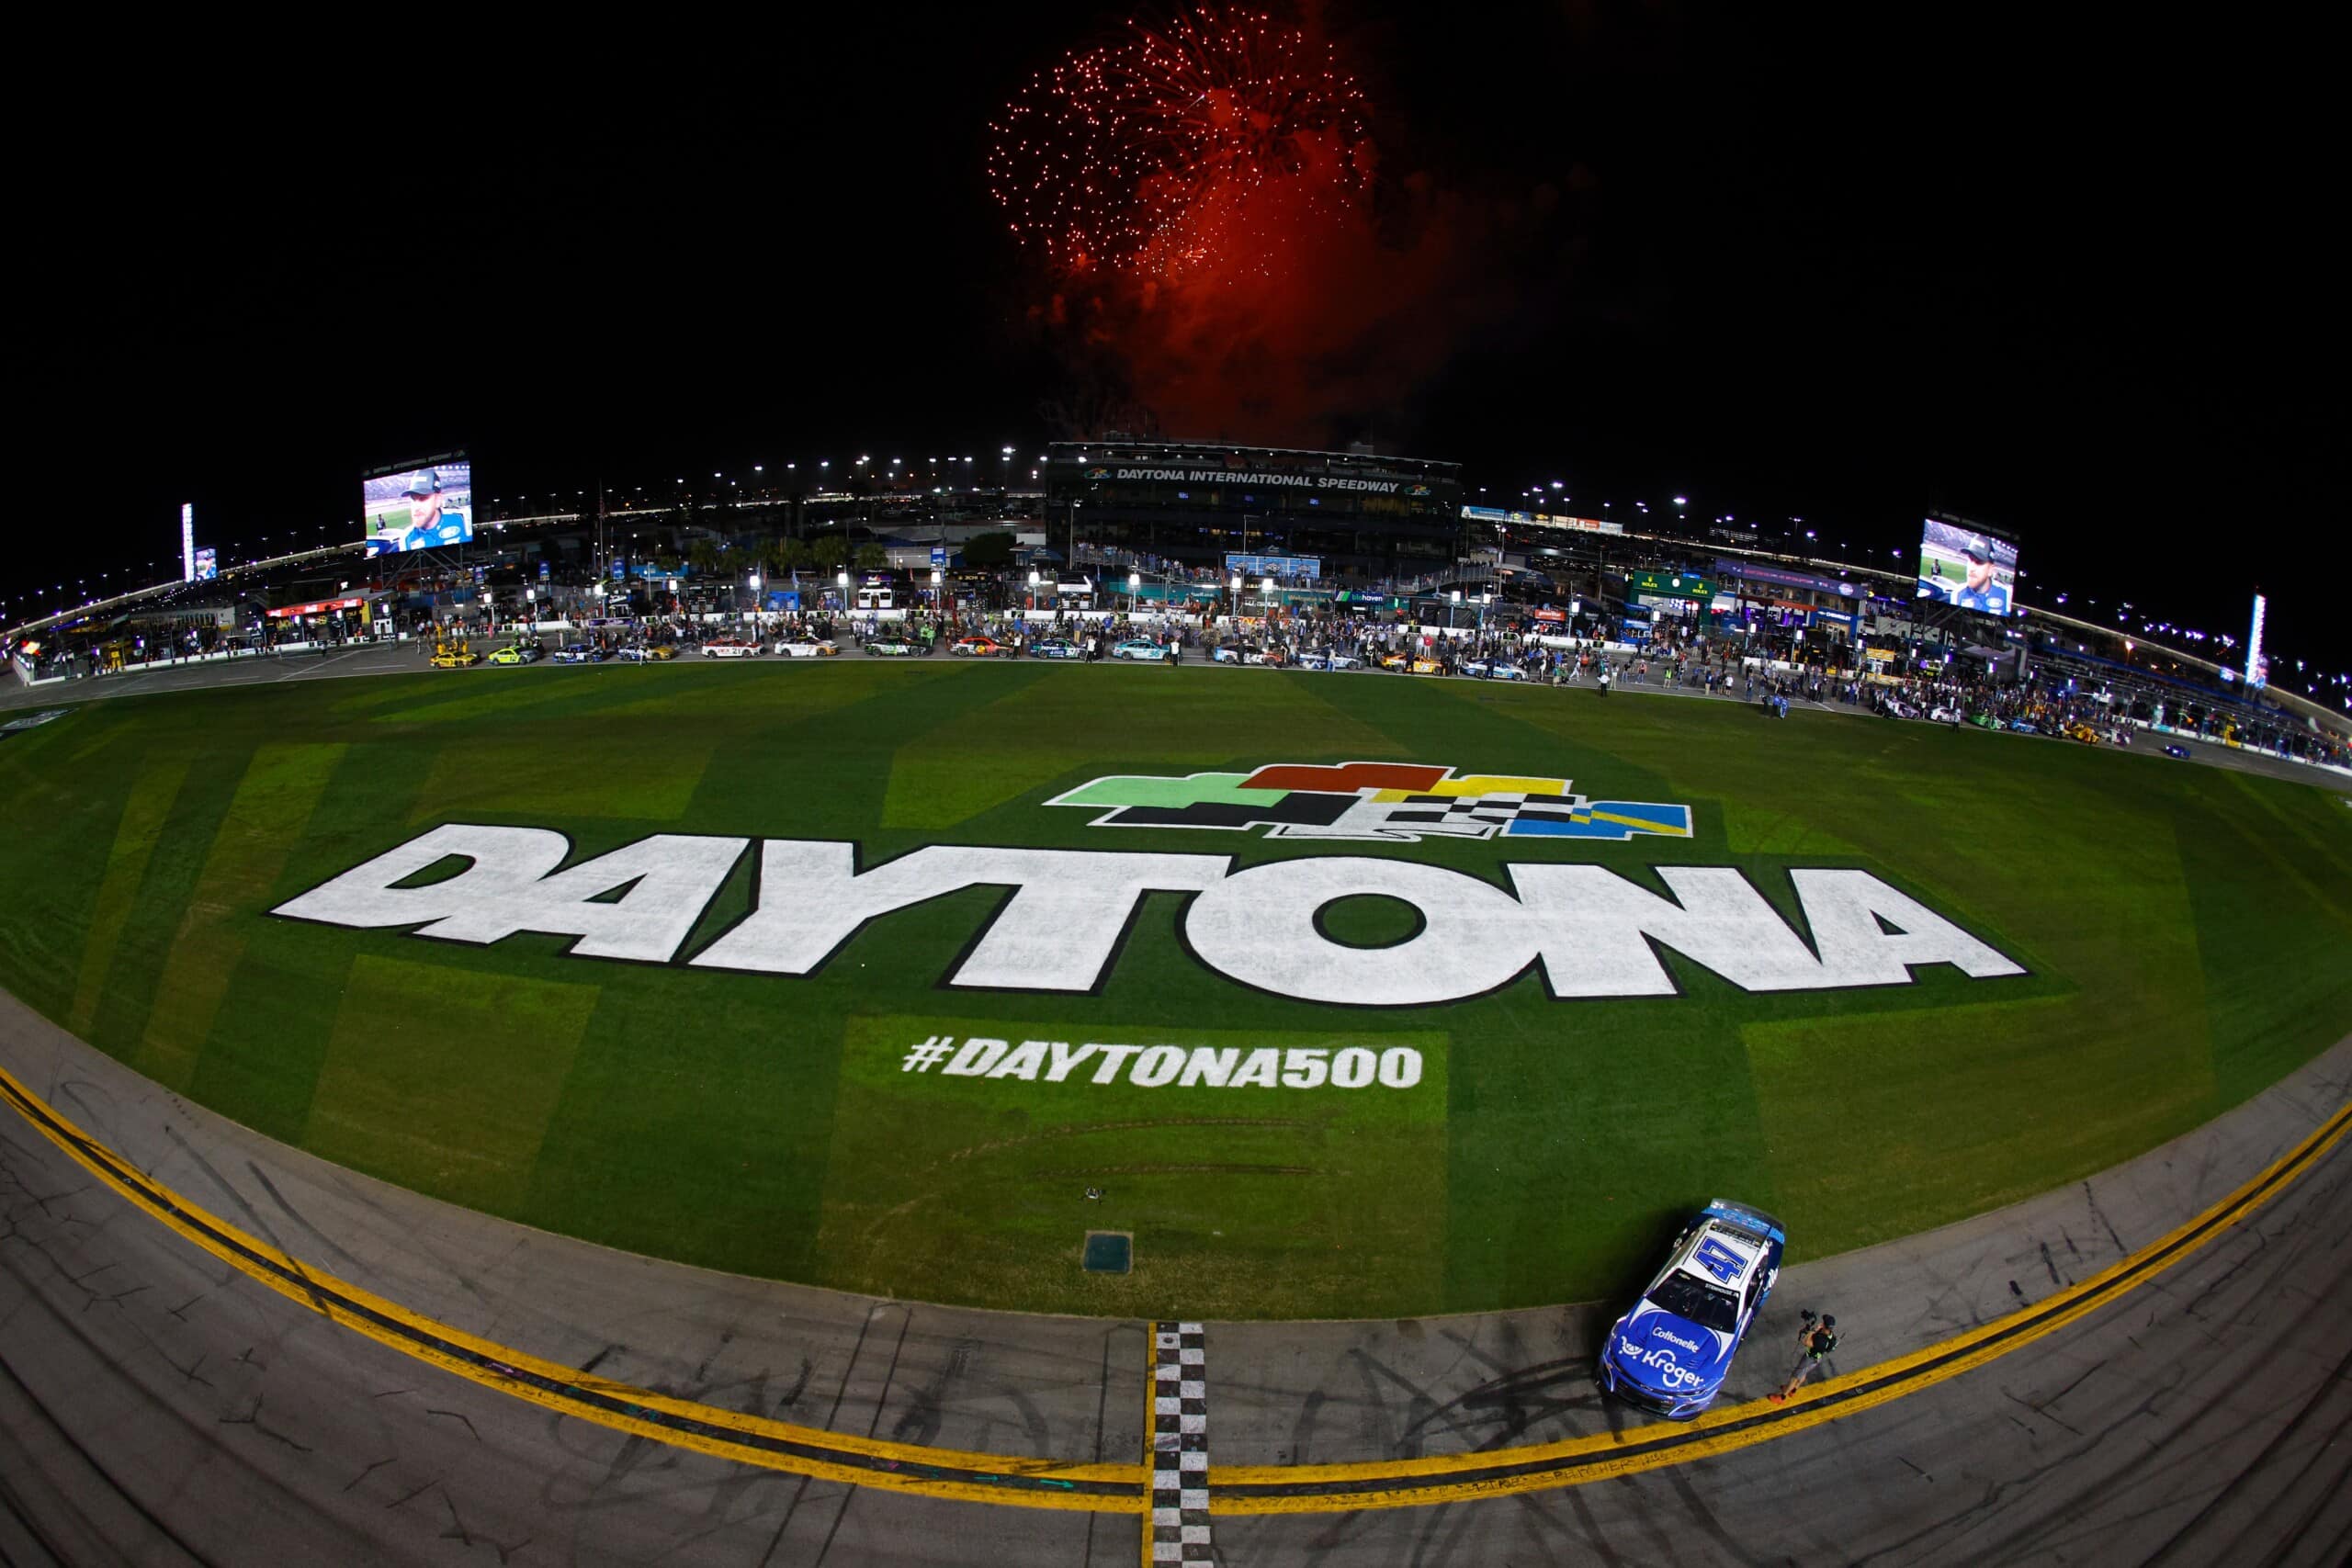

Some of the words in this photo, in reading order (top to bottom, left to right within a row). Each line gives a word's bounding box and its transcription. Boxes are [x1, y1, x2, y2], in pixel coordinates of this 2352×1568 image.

[1116, 468, 1185, 481] DAYTONA
[1189, 470, 1314, 488] INTERNATIONAL
[1317, 476, 1399, 494] SPEEDWAY
[1352, 592, 1383, 603] biohaven
[269, 822, 2030, 1007] DAYTONA
[901, 1035, 1423, 1089] #DAYTONA500
[1693, 1235, 1748, 1285] 47
[1652, 1326, 1700, 1353] Cottonelle
[1642, 1348, 1704, 1388] Kroger
